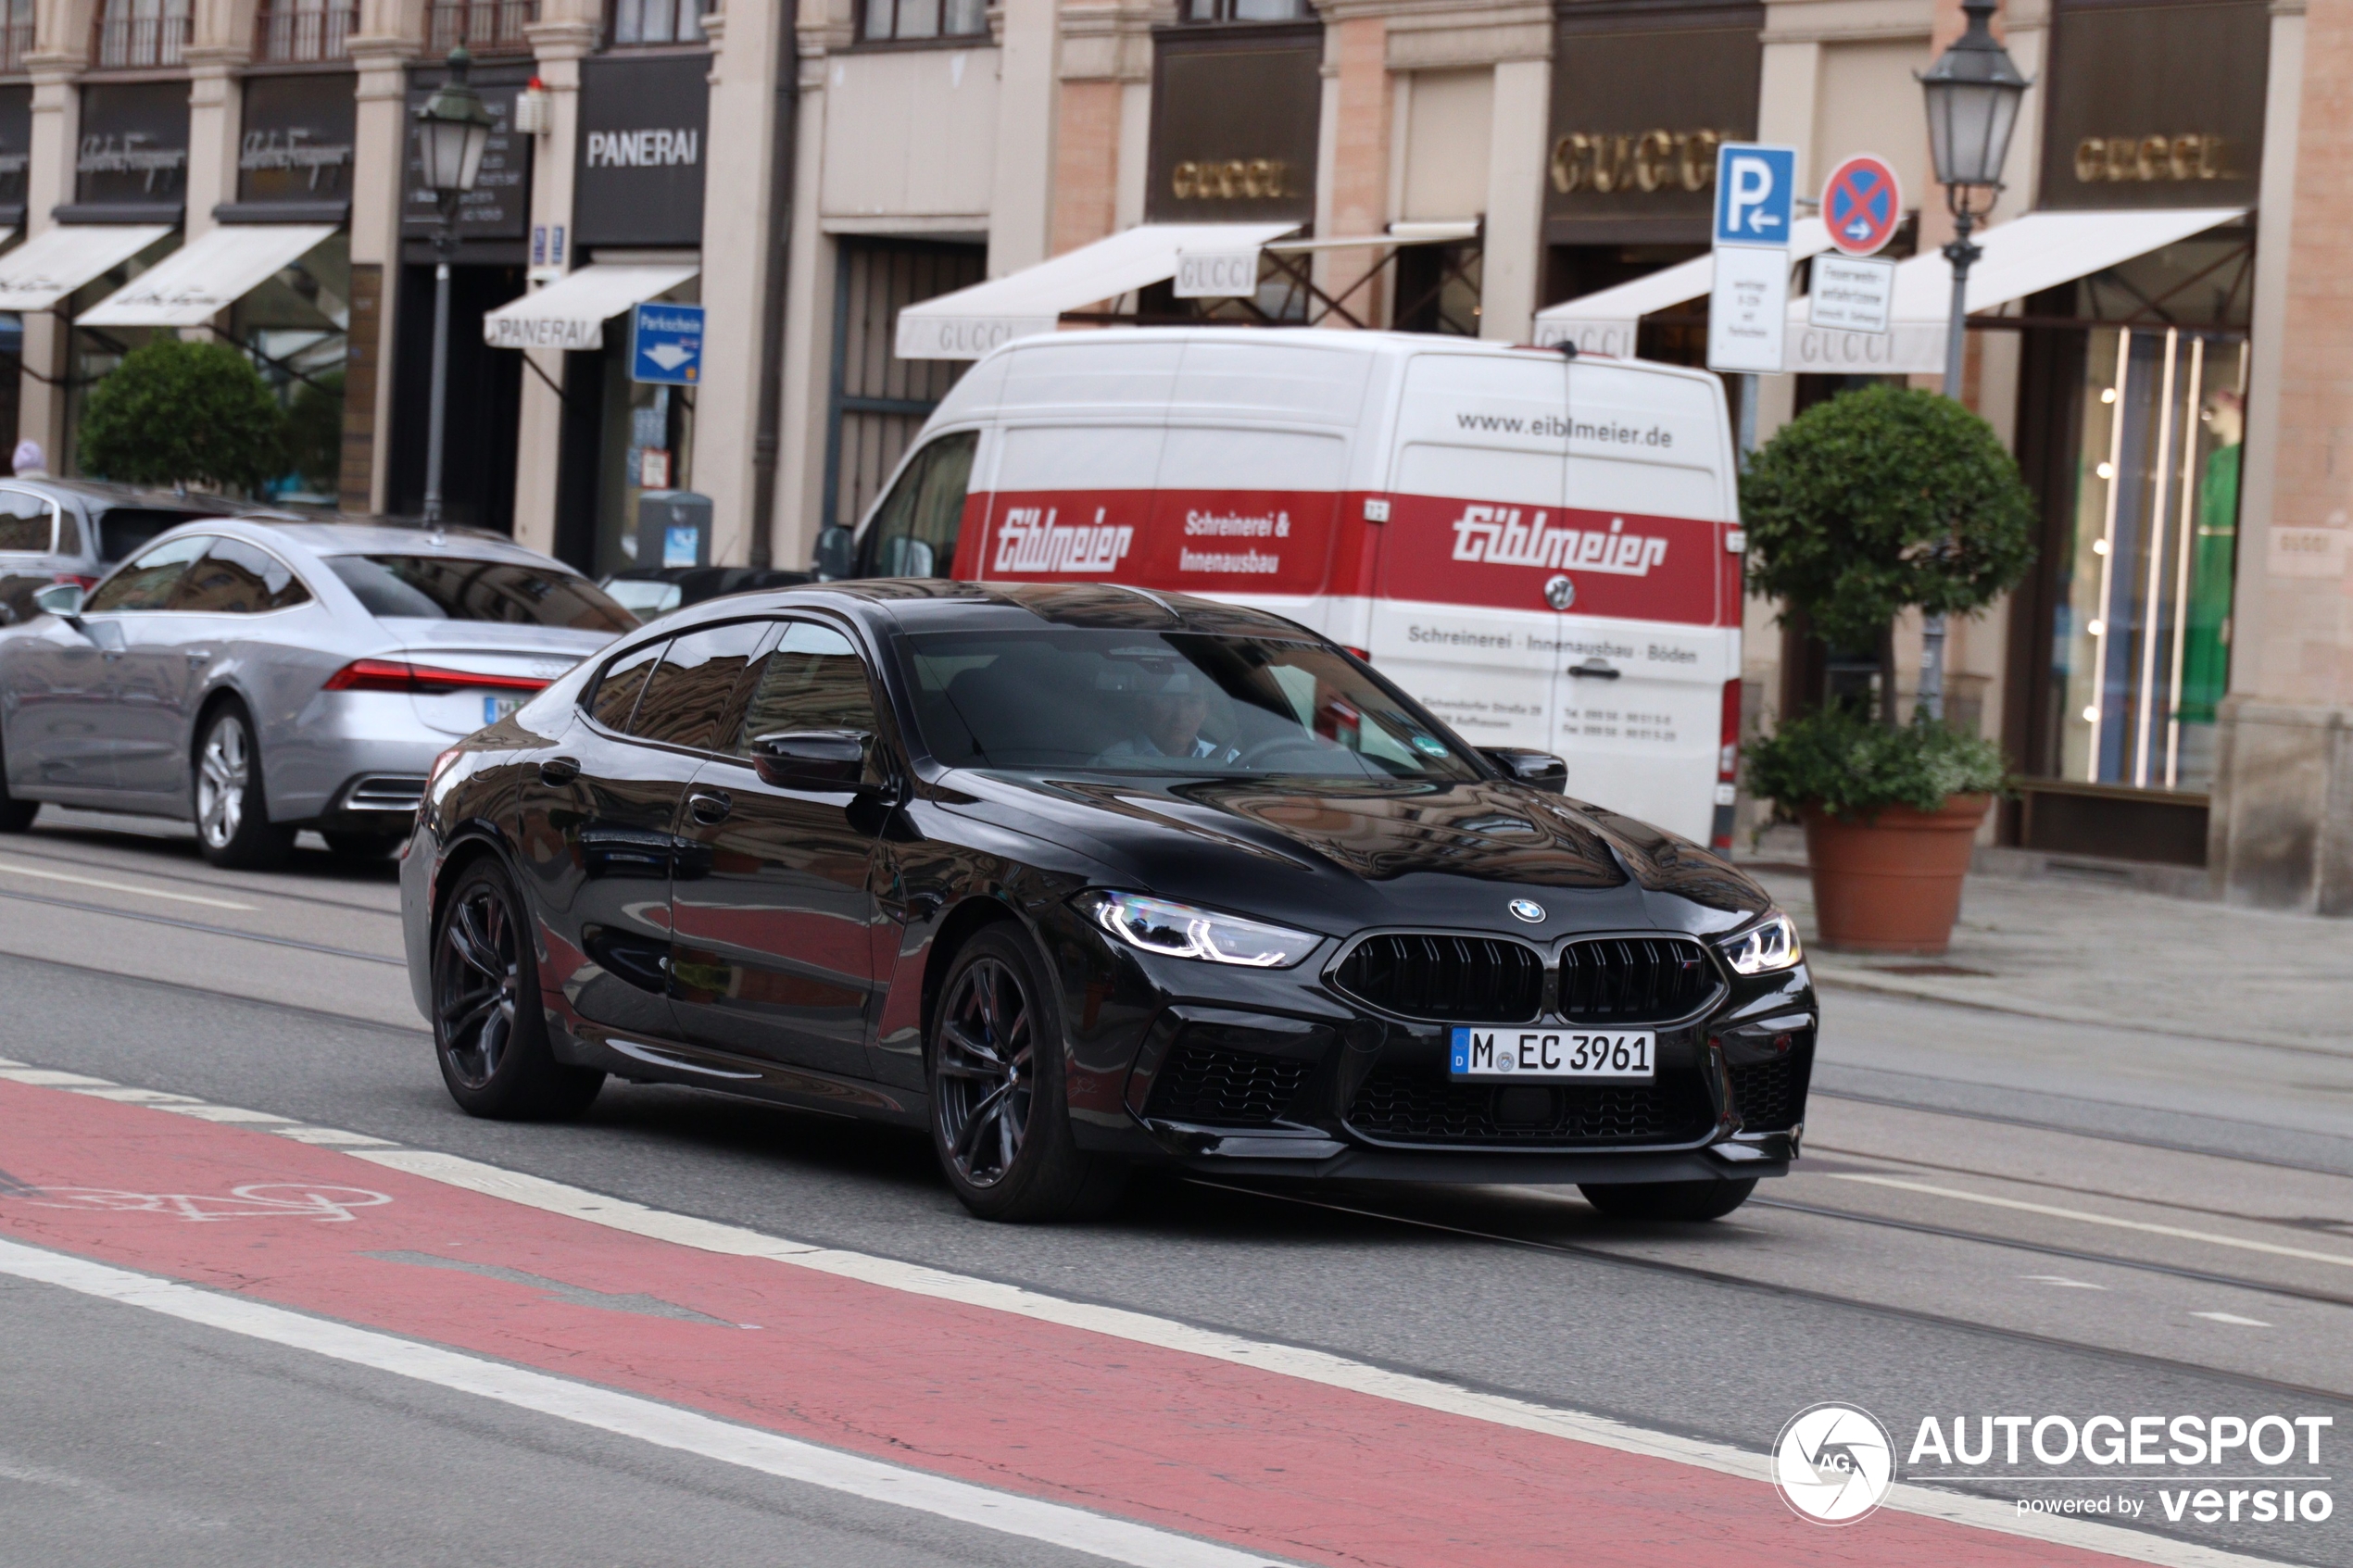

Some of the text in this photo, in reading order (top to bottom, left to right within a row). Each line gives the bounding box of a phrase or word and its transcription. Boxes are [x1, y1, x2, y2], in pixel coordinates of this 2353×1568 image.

[586, 129, 698, 168] PANERAI
[1728, 157, 1773, 232] P
[1180, 256, 1252, 289] GUCCI
[498, 319, 586, 345] PANERAI
[1801, 332, 1894, 363] GUCCI
[1457, 412, 1673, 448] www.eiblmeier.de
[1185, 509, 1290, 538] Schreinerei &
[1452, 505, 1668, 577] Eiblmeier
[1179, 546, 1280, 573] Innenausbau
[1407, 625, 1698, 664] Schreinerei Innenausbau Böden
[1455, 1055, 1464, 1066] D
[1472, 1033, 1650, 1072] M EC 3961
